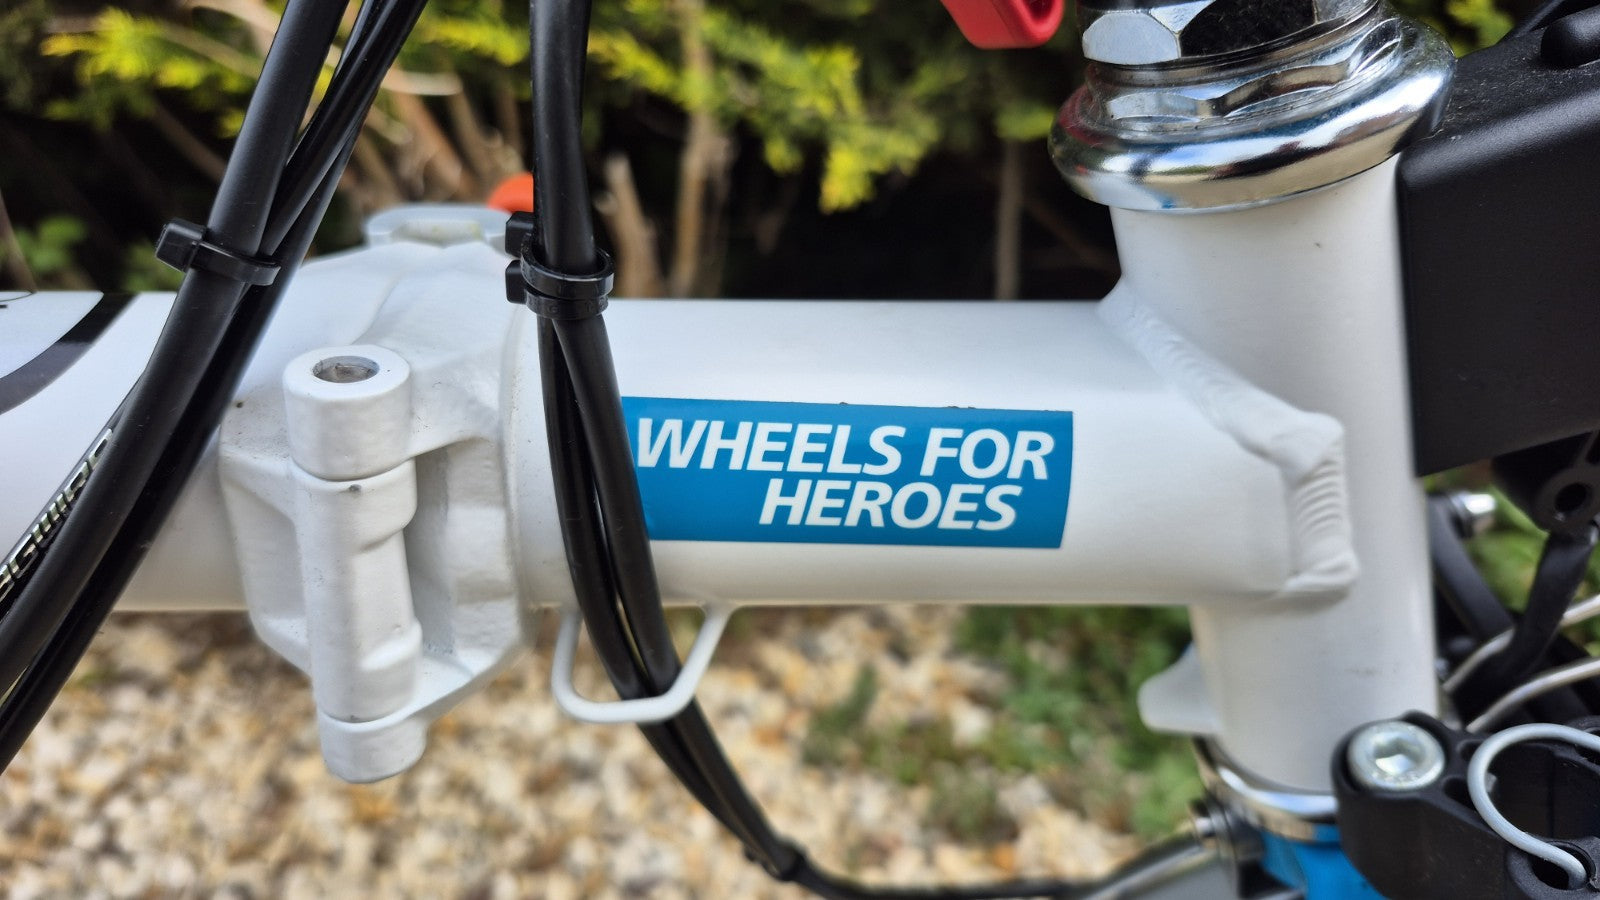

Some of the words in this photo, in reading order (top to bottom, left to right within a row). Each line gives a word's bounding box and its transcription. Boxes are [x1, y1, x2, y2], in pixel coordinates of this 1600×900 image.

[638, 417, 906, 476] WHEELS
[920, 427, 1055, 480] FOR
[759, 478, 1022, 531] HEROES
